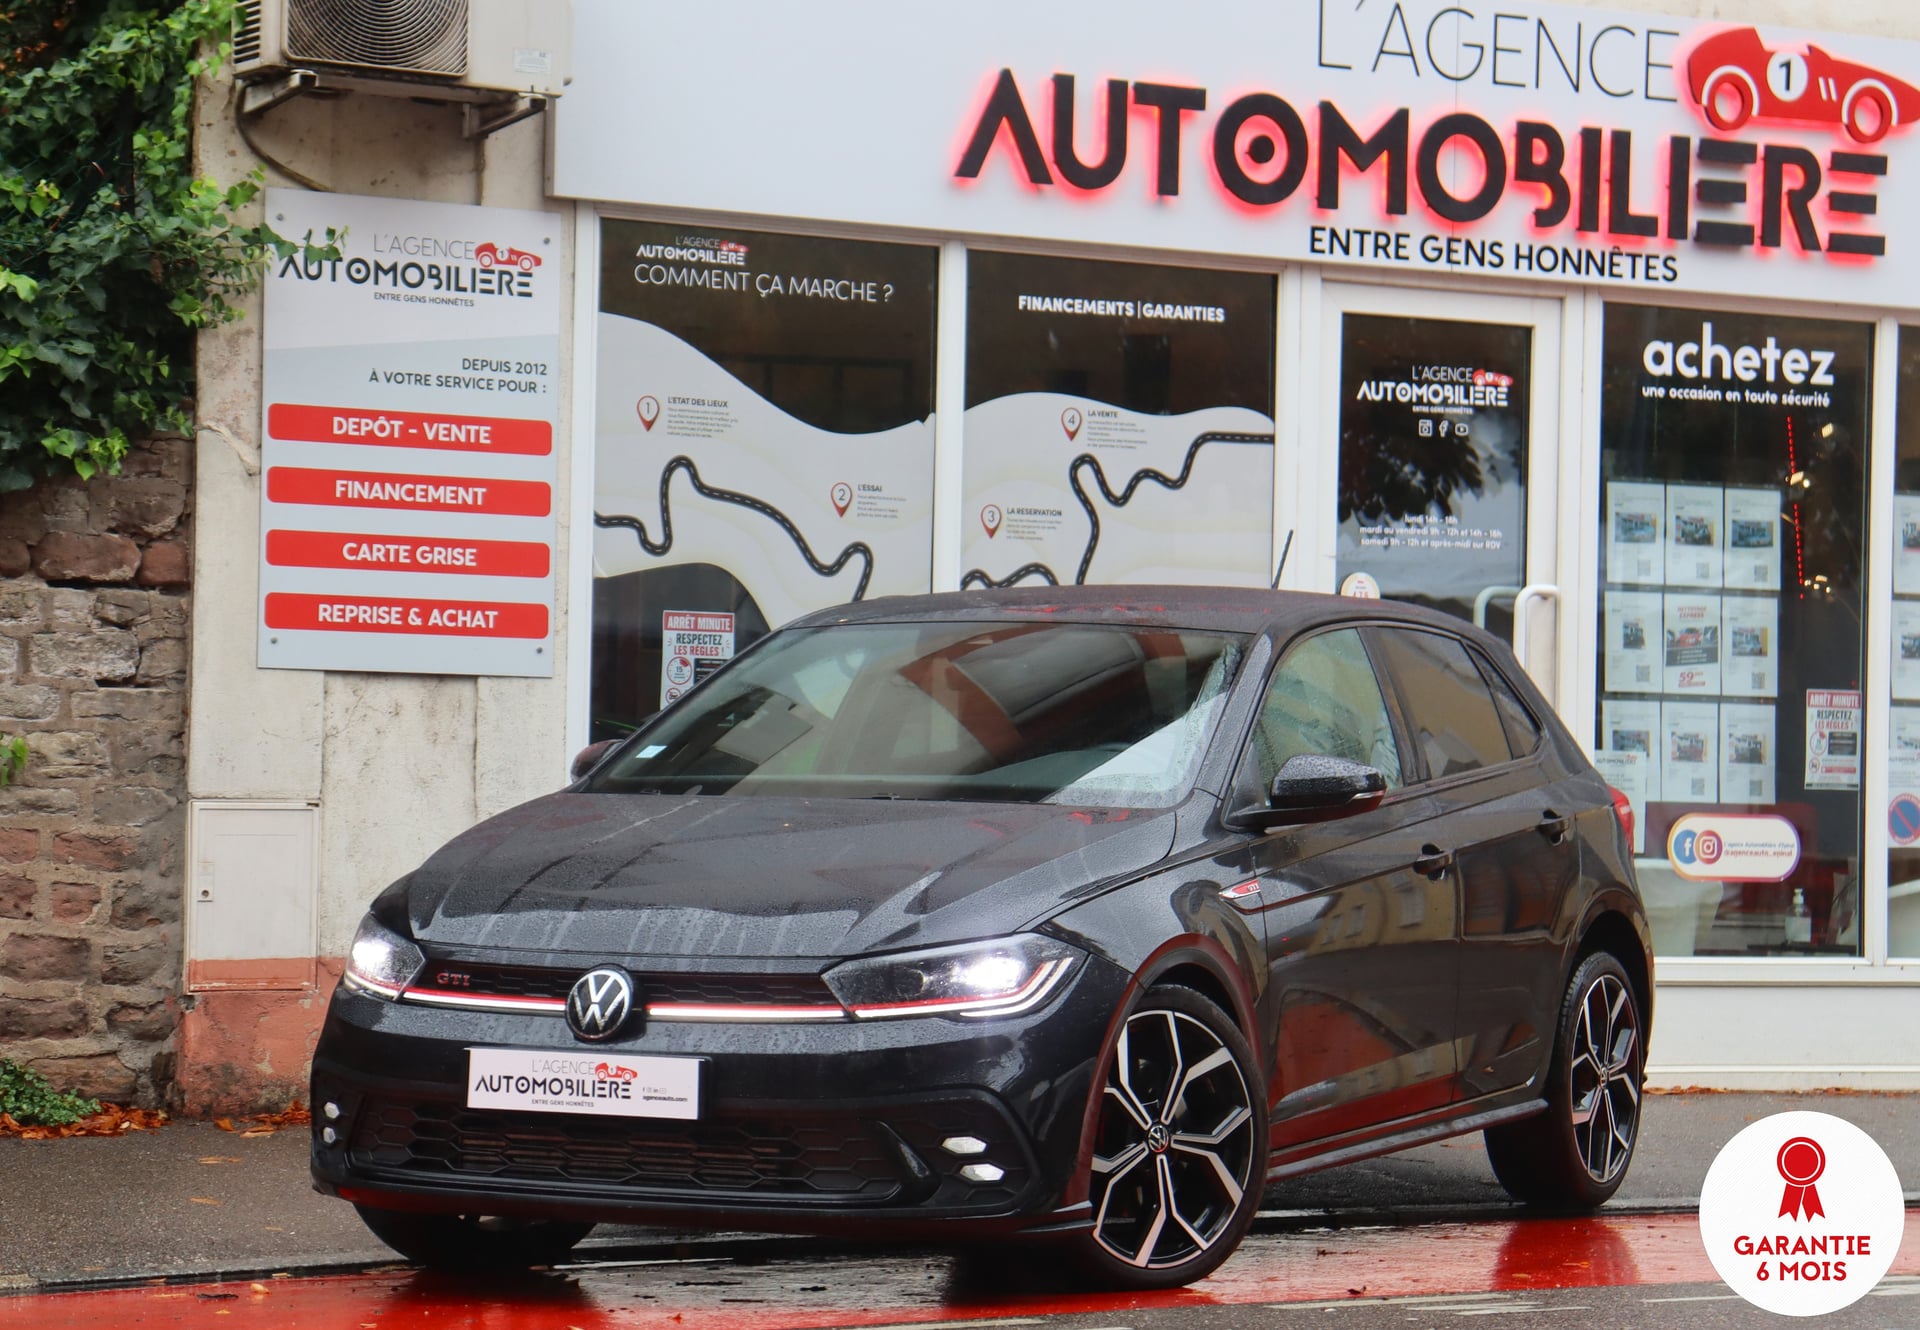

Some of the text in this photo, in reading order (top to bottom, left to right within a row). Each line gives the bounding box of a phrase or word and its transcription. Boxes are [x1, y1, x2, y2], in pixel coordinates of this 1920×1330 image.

[1318, 0, 1680, 102] L'AGENCE
[373, 233, 476, 260] L'AGENCE
[675, 236, 720, 249] L'AGENCE
[1310, 226, 1678, 282] ENTRE GENS HONNÊTES
[634, 263, 894, 303] COMMENT ÇA MARCHE ?
[374, 292, 474, 307] ENTRE GENS HONNÊTES
[1018, 295, 1134, 318] FINANCEMENTS
[1142, 305, 1225, 322] GARANTIES
[1643, 322, 1835, 386] achetez
[462, 358, 547, 376] DEPUIS 2012
[1412, 365, 1473, 383] L'AGENCE
[369, 368, 379, 383] À
[384, 372, 431, 387] VOTRE
[436, 375, 494, 391] SERVICE
[498, 379, 537, 393] POUR
[691, 398, 706, 406] DES
[707, 399, 728, 408] LIEUX
[1642, 385, 1830, 408] une occasion en toute sécurité
[1067, 414, 1075, 425] 4
[332, 416, 403, 438] DEPÔT
[423, 422, 492, 444] VENTE
[335, 480, 487, 506] FINANCEMENT
[838, 488, 846, 501] 2
[987, 510, 995, 523] 3
[1006, 507, 1015, 515] LA
[1405, 514, 1424, 524] lundi
[1359, 525, 1382, 534] mardi
[1395, 526, 1429, 536] vendredi
[1460, 528, 1468, 536] et
[1360, 537, 1389, 546] samedi
[1421, 539, 1429, 547] et
[1485, 541, 1501, 549] RDV
[342, 543, 477, 567] CARTE GRISE
[318, 604, 498, 629] REPRISE & ACHAT
[668, 614, 731, 631] ARRÊT MINUTE
[676, 633, 722, 646] RESPECTEZ
[674, 645, 688, 656] LES
[436, 972, 471, 987] GTI
[531, 1059, 595, 1076] L'AGENCE
